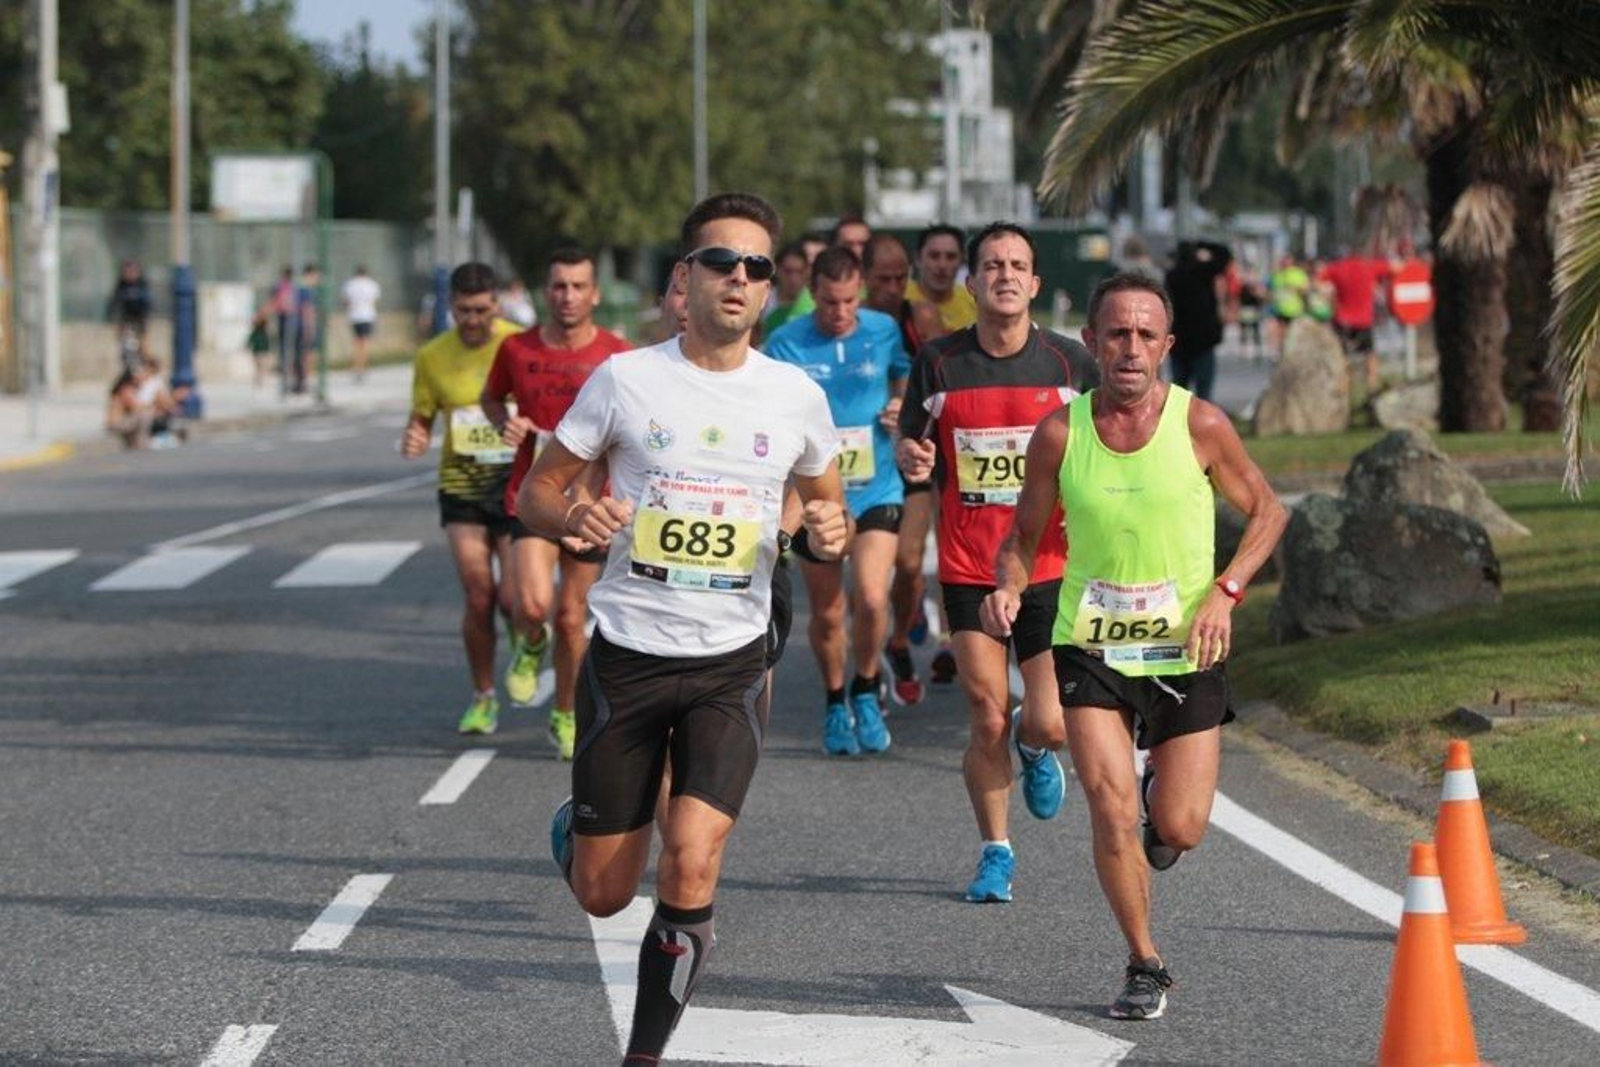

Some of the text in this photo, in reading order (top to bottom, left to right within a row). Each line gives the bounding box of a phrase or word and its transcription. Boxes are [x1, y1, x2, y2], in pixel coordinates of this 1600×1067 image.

[467, 426, 496, 444] 48
[972, 455, 1025, 481] 790
[659, 518, 736, 558] 683
[1086, 616, 1170, 643] 1062
